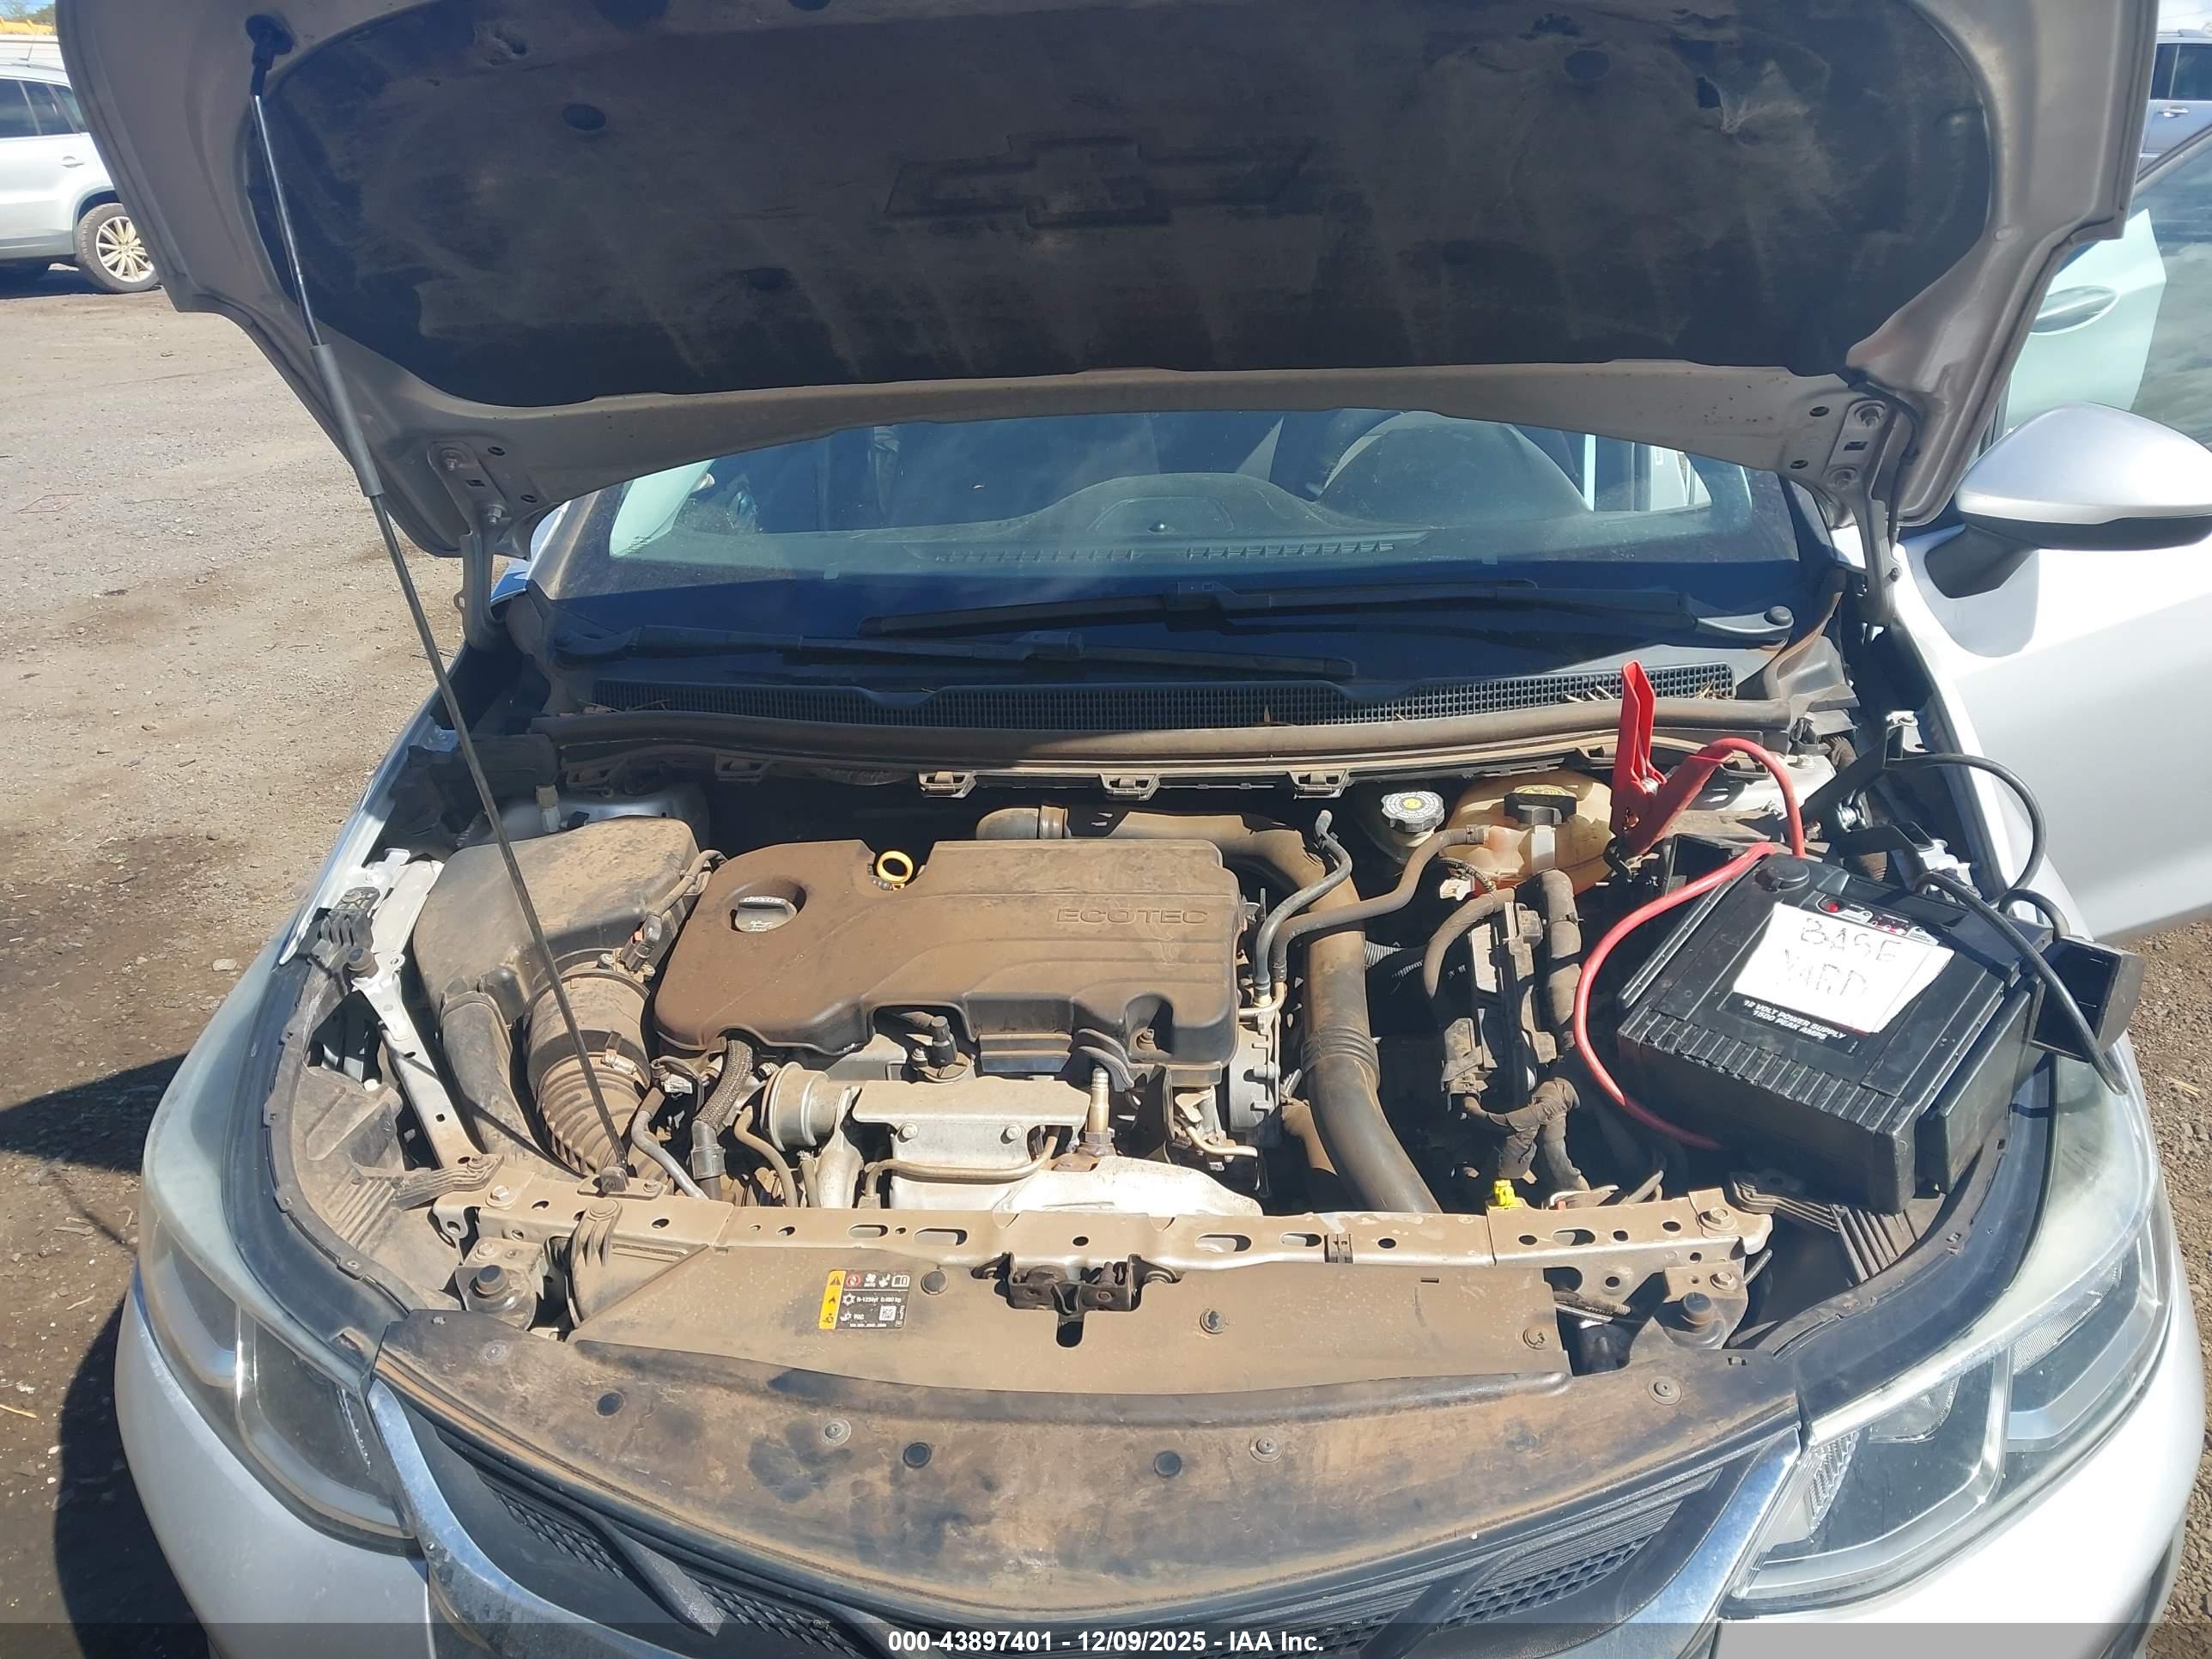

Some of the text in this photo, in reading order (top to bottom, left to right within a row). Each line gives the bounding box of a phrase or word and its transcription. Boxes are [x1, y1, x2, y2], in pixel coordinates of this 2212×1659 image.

[1056, 907, 1209, 925] ECOTEC
[1800, 917, 1903, 961] BASE
[1744, 1000, 1847, 1040] 12 VOLT POWER SUPPLY
[1753, 1010, 1827, 1040] 1500 PEAK AMPS
